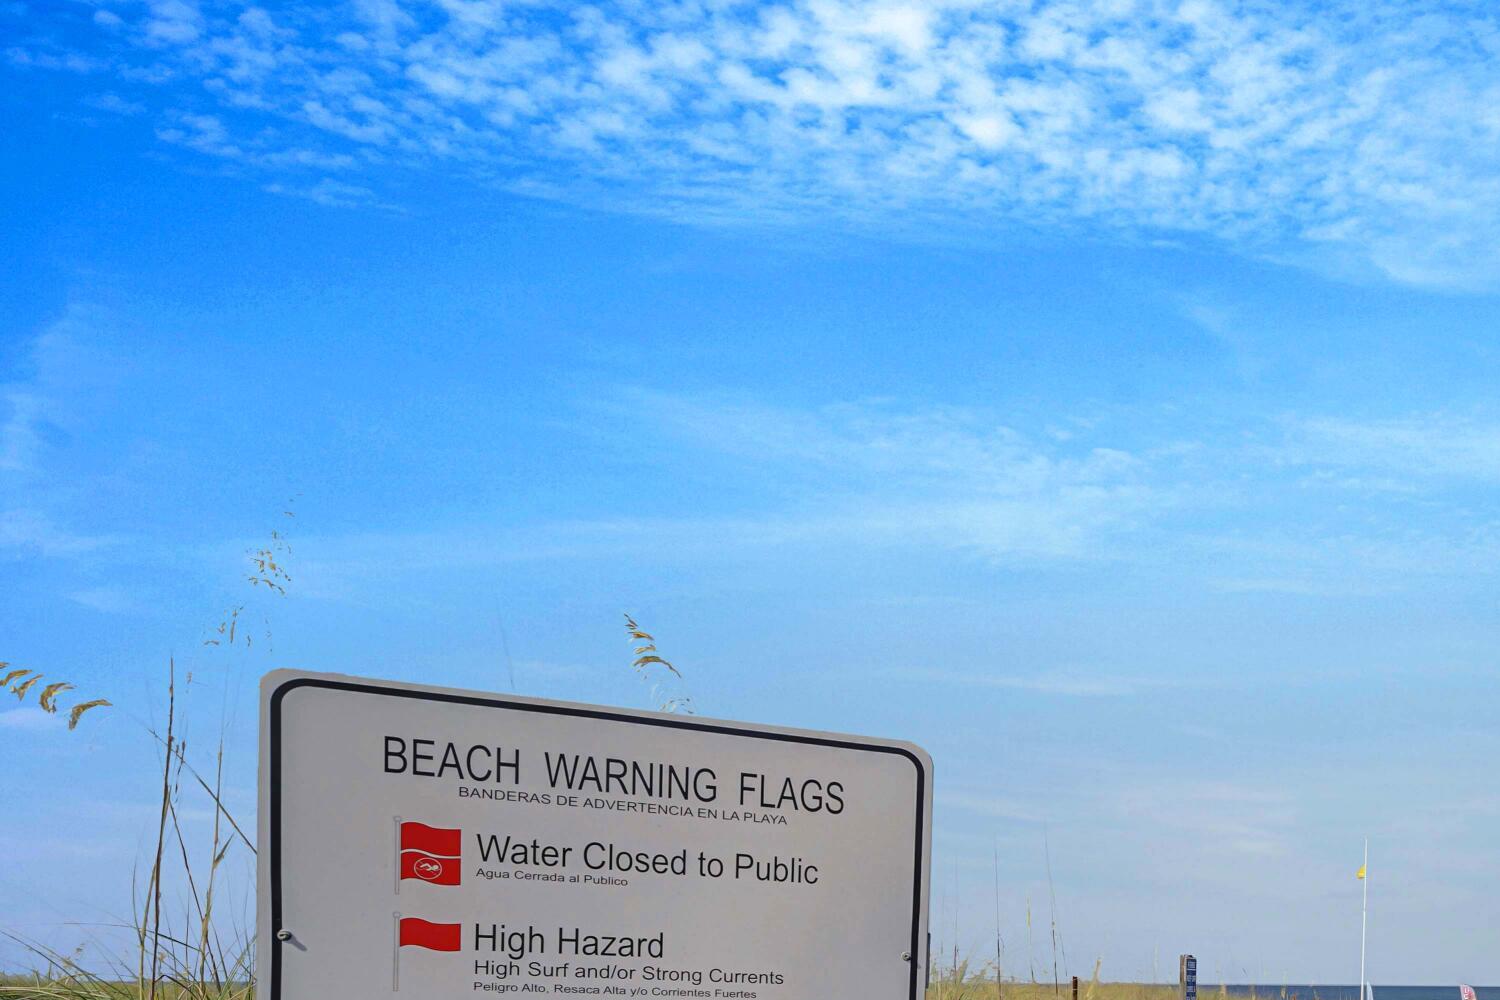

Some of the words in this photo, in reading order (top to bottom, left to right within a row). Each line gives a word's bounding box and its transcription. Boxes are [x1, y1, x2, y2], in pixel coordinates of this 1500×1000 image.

[384, 736, 519, 784] BEACH
[544, 751, 717, 804] WARNING
[740, 773, 844, 814] FLAGS
[459, 787, 551, 804] BANDERAS
[557, 796, 578, 807] DE
[583, 798, 693, 816] ADVERTENCIA
[698, 808, 717, 819] EN
[723, 810, 740, 821] LA
[744, 812, 787, 825] PLAYA
[476, 868, 510, 880] Agua
[514, 871, 565, 882] Cerrada
[569, 875, 580, 883] al
[584, 875, 628, 886] Publico
[477, 834, 572, 867] Water
[584, 842, 686, 875] Closed
[698, 852, 723, 878] to
[736, 854, 818, 884] Public
[476, 924, 544, 963] High
[559, 928, 663, 958] Hazard
[474, 982, 518, 994] Peligro
[554, 984, 600, 994] Resaca
[603, 986, 626, 995] Alta
[630, 987, 648, 997] y/o
[652, 988, 711, 997] Corrientes
[715, 989, 757, 999] Fuertes
[475, 960, 520, 979] High
[528, 962, 569, 977] Surf
[575, 965, 636, 979] and/or
[643, 966, 702, 985] Strong
[710, 969, 784, 985] Currents
